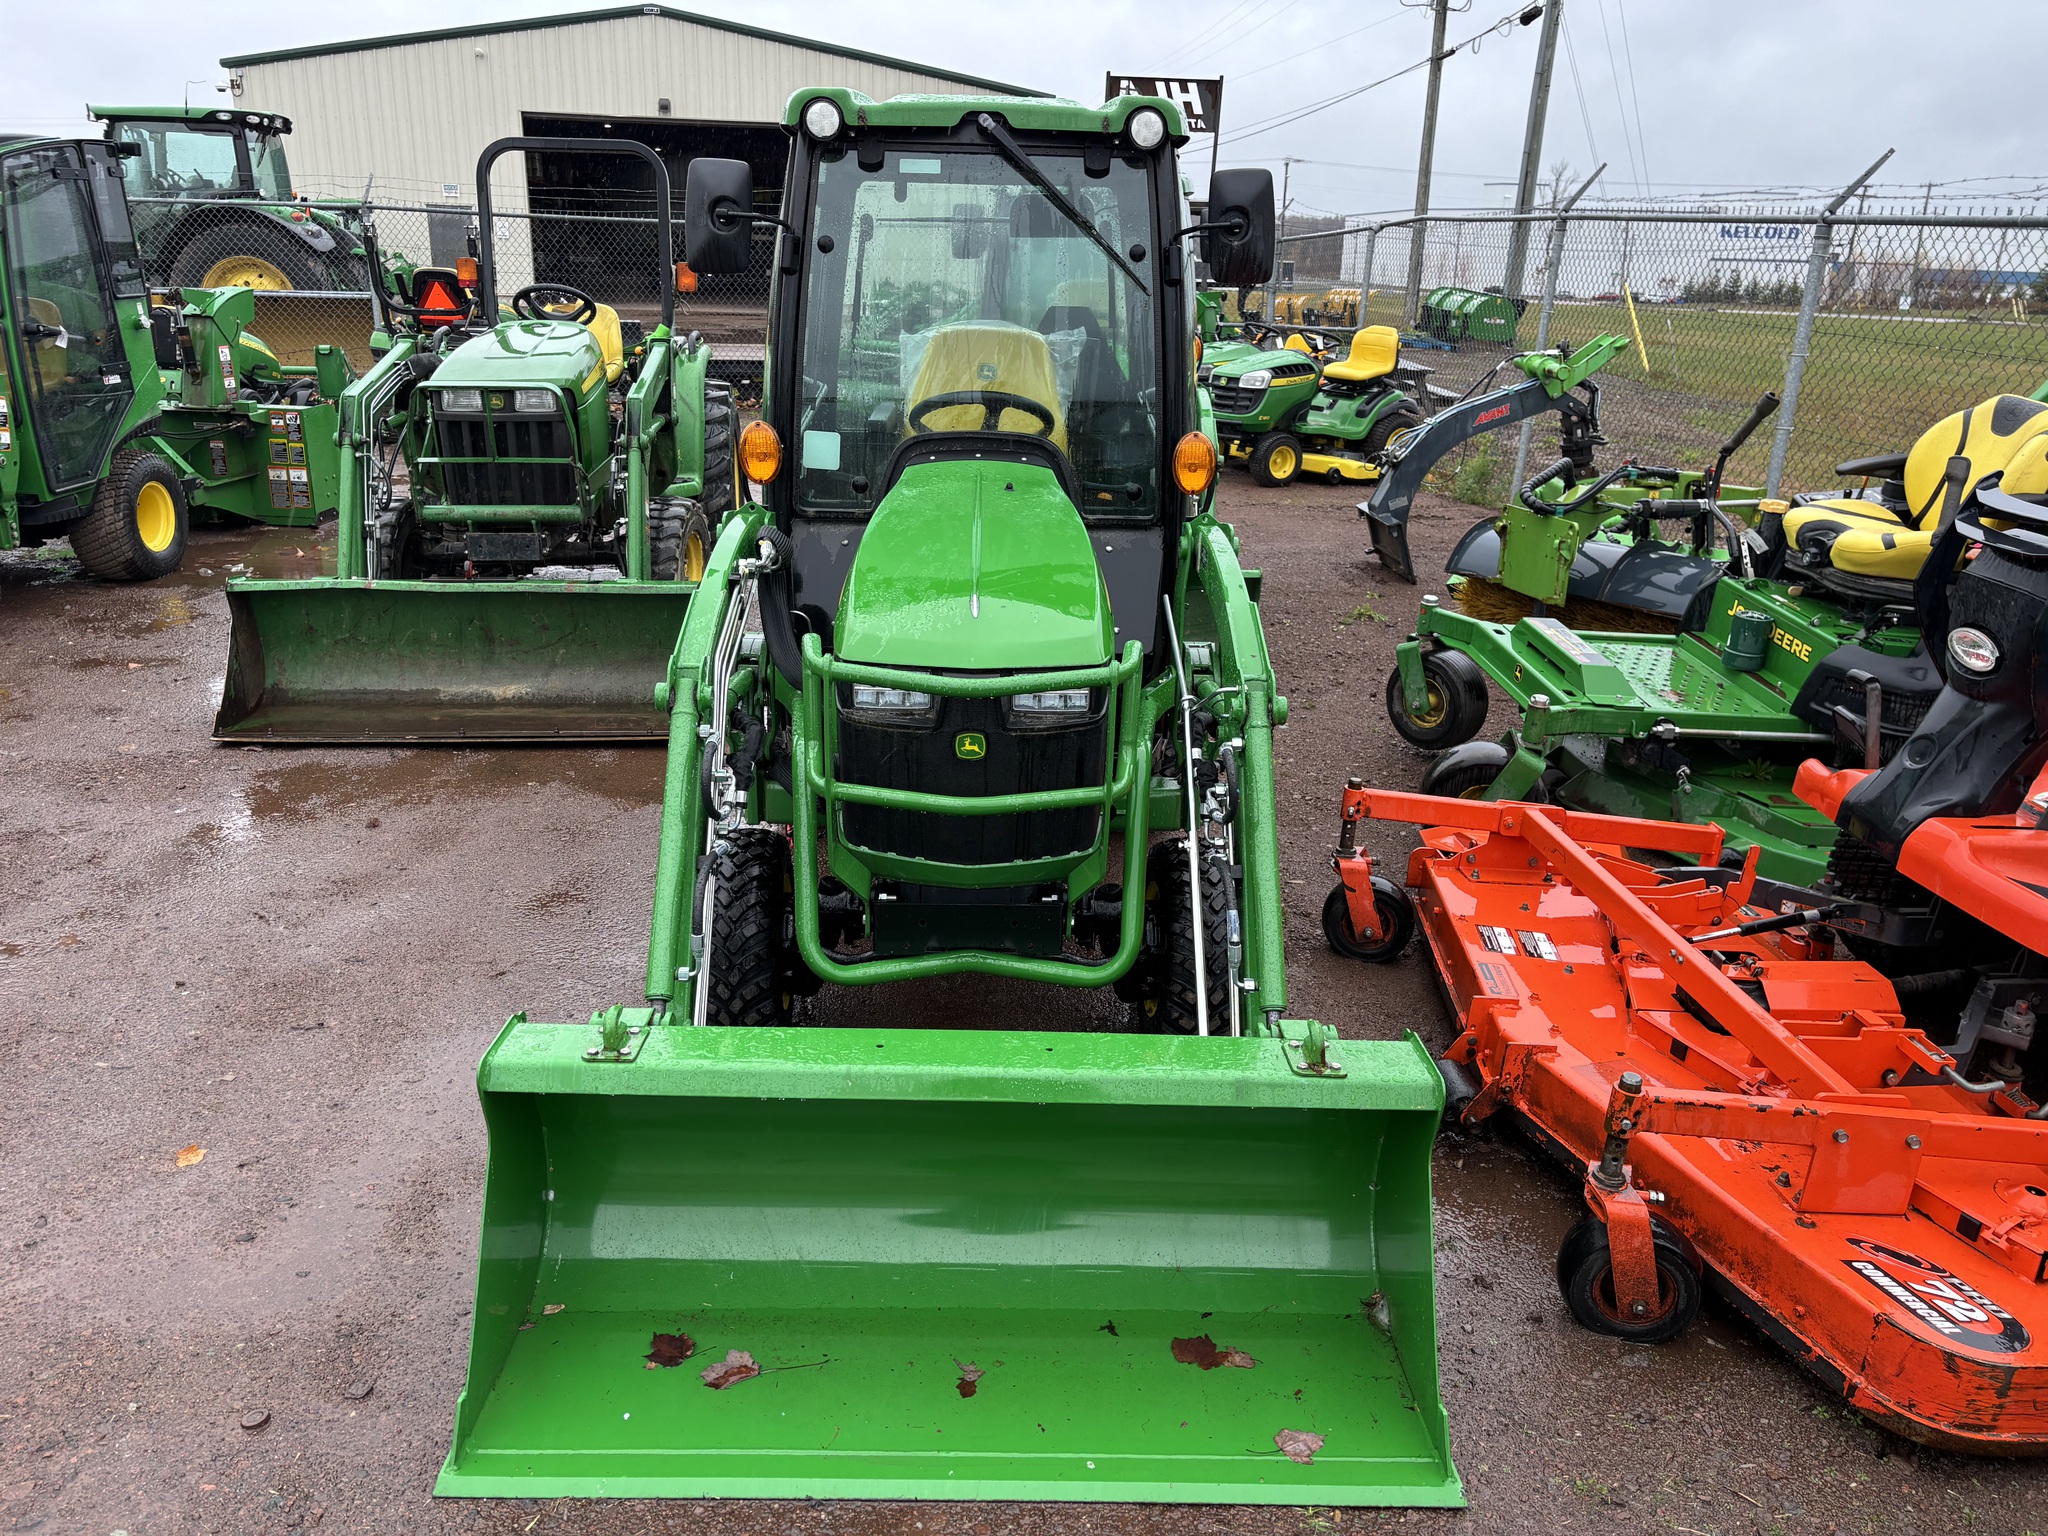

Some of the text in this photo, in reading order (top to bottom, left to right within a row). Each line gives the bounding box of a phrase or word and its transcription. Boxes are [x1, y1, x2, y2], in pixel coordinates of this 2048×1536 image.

[1720, 224, 1800, 240] KELCOLD
[1473, 403, 1511, 427] AVANT
[1851, 1261, 1963, 1335] COMMERCIAL
[1906, 1279, 1989, 1323] 72
